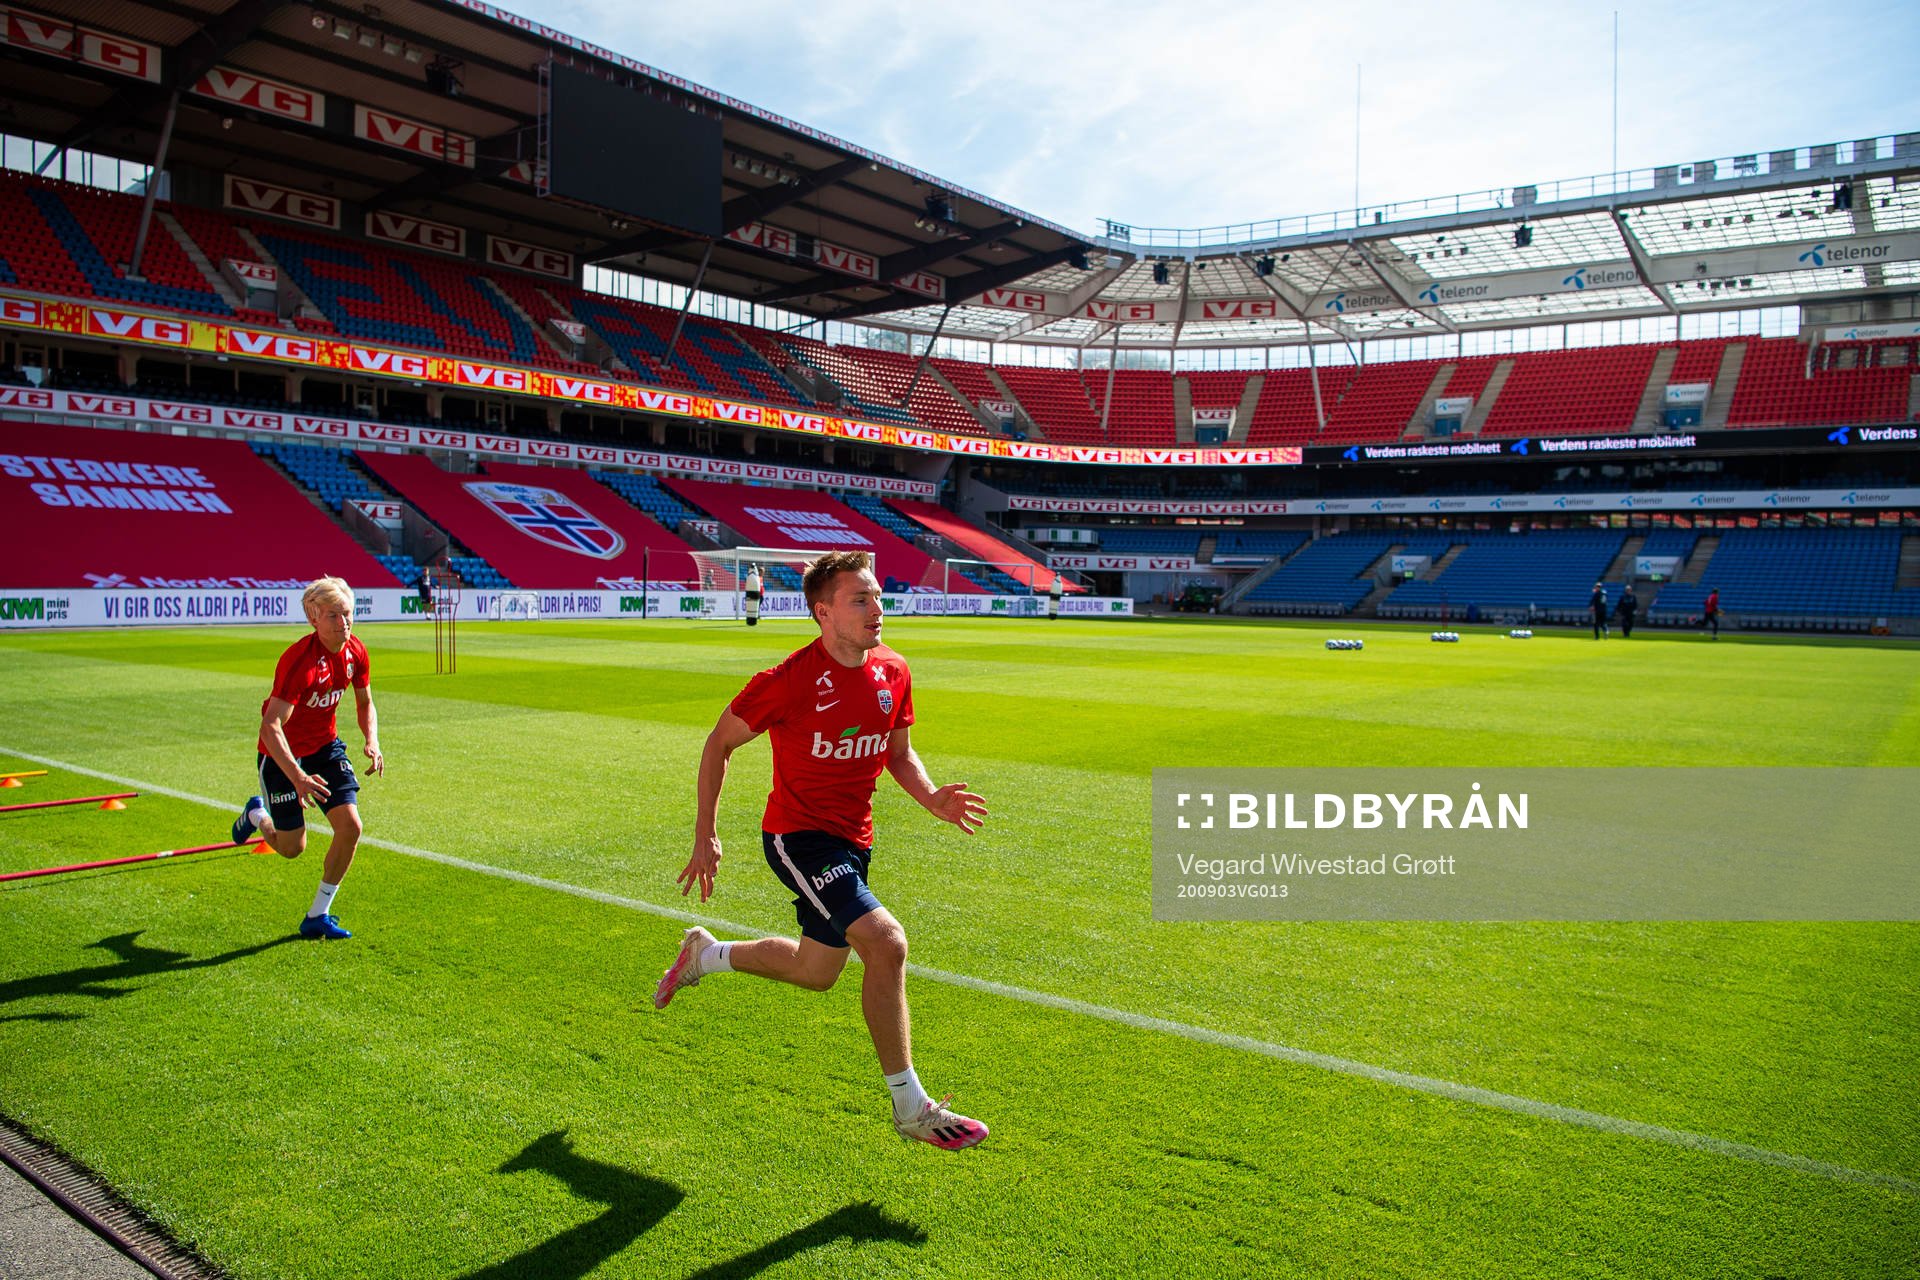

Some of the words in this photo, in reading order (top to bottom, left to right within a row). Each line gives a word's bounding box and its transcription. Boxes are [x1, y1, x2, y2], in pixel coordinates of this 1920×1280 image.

[15, 17, 140, 73] VG
[205, 70, 307, 119] VG
[371, 113, 461, 161] VG
[236, 182, 328, 224] VG
[374, 213, 456, 252] VG
[493, 241, 565, 275] VG
[822, 243, 872, 276] VG
[1827, 244, 1890, 262] telenor
[232, 262, 272, 280] VG
[988, 290, 1043, 310] VG
[1440, 284, 1488, 299] telenor
[1091, 303, 1152, 319] VG
[1208, 301, 1273, 317] VG
[1345, 295, 1390, 309] telenor
[92, 310, 183, 344] VG
[231, 331, 312, 361] VG
[354, 349, 427, 377] VG
[459, 365, 526, 390] VG
[555, 378, 611, 402] VG
[639, 391, 690, 412] VG
[713, 403, 761, 423] VG
[782, 413, 824, 432] VG
[843, 422, 881, 440] VG
[898, 431, 934, 447] VG
[949, 438, 989, 454] VG
[1008, 444, 1051, 459] VG
[1071, 449, 1121, 463] VG
[1144, 450, 1196, 464] VG
[1221, 450, 1272, 464] VG
[1198, 410, 1230, 420] VG
[69, 395, 133, 416] VG
[151, 404, 209, 423] VG
[226, 412, 280, 430] VG
[296, 418, 348, 436] VG
[360, 425, 408, 442] VG
[421, 432, 465, 447] VG
[478, 437, 518, 452] VG
[530, 443, 569, 457] VG
[580, 448, 616, 462] VG
[625, 452, 659, 466] VG
[669, 457, 701, 471] VG
[710, 462, 740, 475] VG
[748, 466, 777, 479] VG
[785, 470, 811, 481] VG
[818, 473, 844, 485] VG
[851, 477, 875, 488] VG
[882, 480, 904, 491] VG
[911, 483, 933, 494] VG
[1541, 438, 1588, 452] Verdens
[1589, 437, 1636, 450] raskeste
[1637, 435, 1696, 449] mobilnett
[1859, 427, 1918, 442] Verdens
[1365, 446, 1406, 459] Verdens
[1407, 444, 1449, 457] raskeste
[1450, 441, 1501, 456] mobilnett
[0, 454, 216, 488] STERKERE
[31, 482, 233, 514] SAMMEN
[1010, 498, 1043, 510] VG
[1047, 500, 1080, 511] VG
[1083, 501, 1118, 512] VG
[1123, 502, 1159, 513] VG
[1165, 503, 1200, 513] VG
[1206, 503, 1244, 513] VG
[1249, 503, 1286, 513] VG
[1053, 558, 1086, 568] VG
[1101, 558, 1136, 569] VG
[1151, 559, 1189, 570] VG
[47, 598, 70, 609] mini
[104, 596, 119, 619] VI
[125, 596, 148, 618] GIR
[154, 596, 181, 618] OSS
[186, 596, 227, 618] ALDRI
[232, 591, 249, 617] PÅ
[254, 596, 287, 617] PRIS!
[477, 596, 487, 613] VI
[563, 592, 575, 613] PÅ
[578, 596, 601, 613] PRIS!
[47, 609, 68, 621] pris
[306, 688, 344, 708] bam
[811, 731, 891, 760] bama
[811, 863, 854, 891] bama
